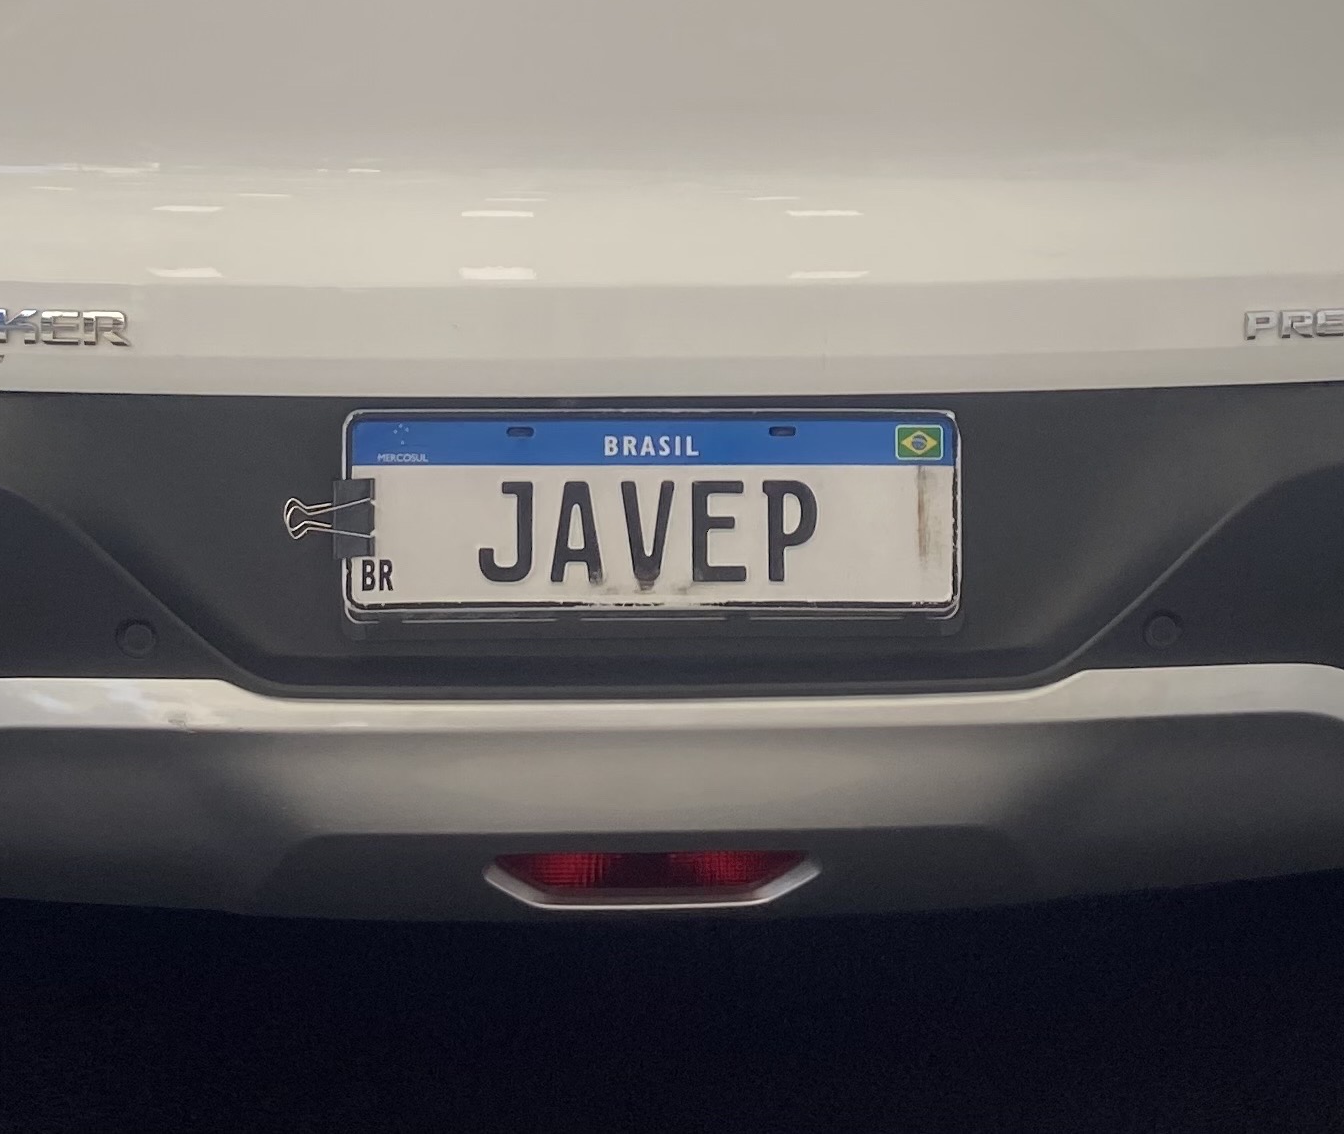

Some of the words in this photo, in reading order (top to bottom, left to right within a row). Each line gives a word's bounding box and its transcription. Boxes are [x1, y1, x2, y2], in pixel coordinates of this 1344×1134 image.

[377, 453, 429, 462] MERCOSUL
[604, 435, 700, 457] BRASIL
[478, 480, 818, 583] JAVEP
[361, 559, 394, 592] BR
